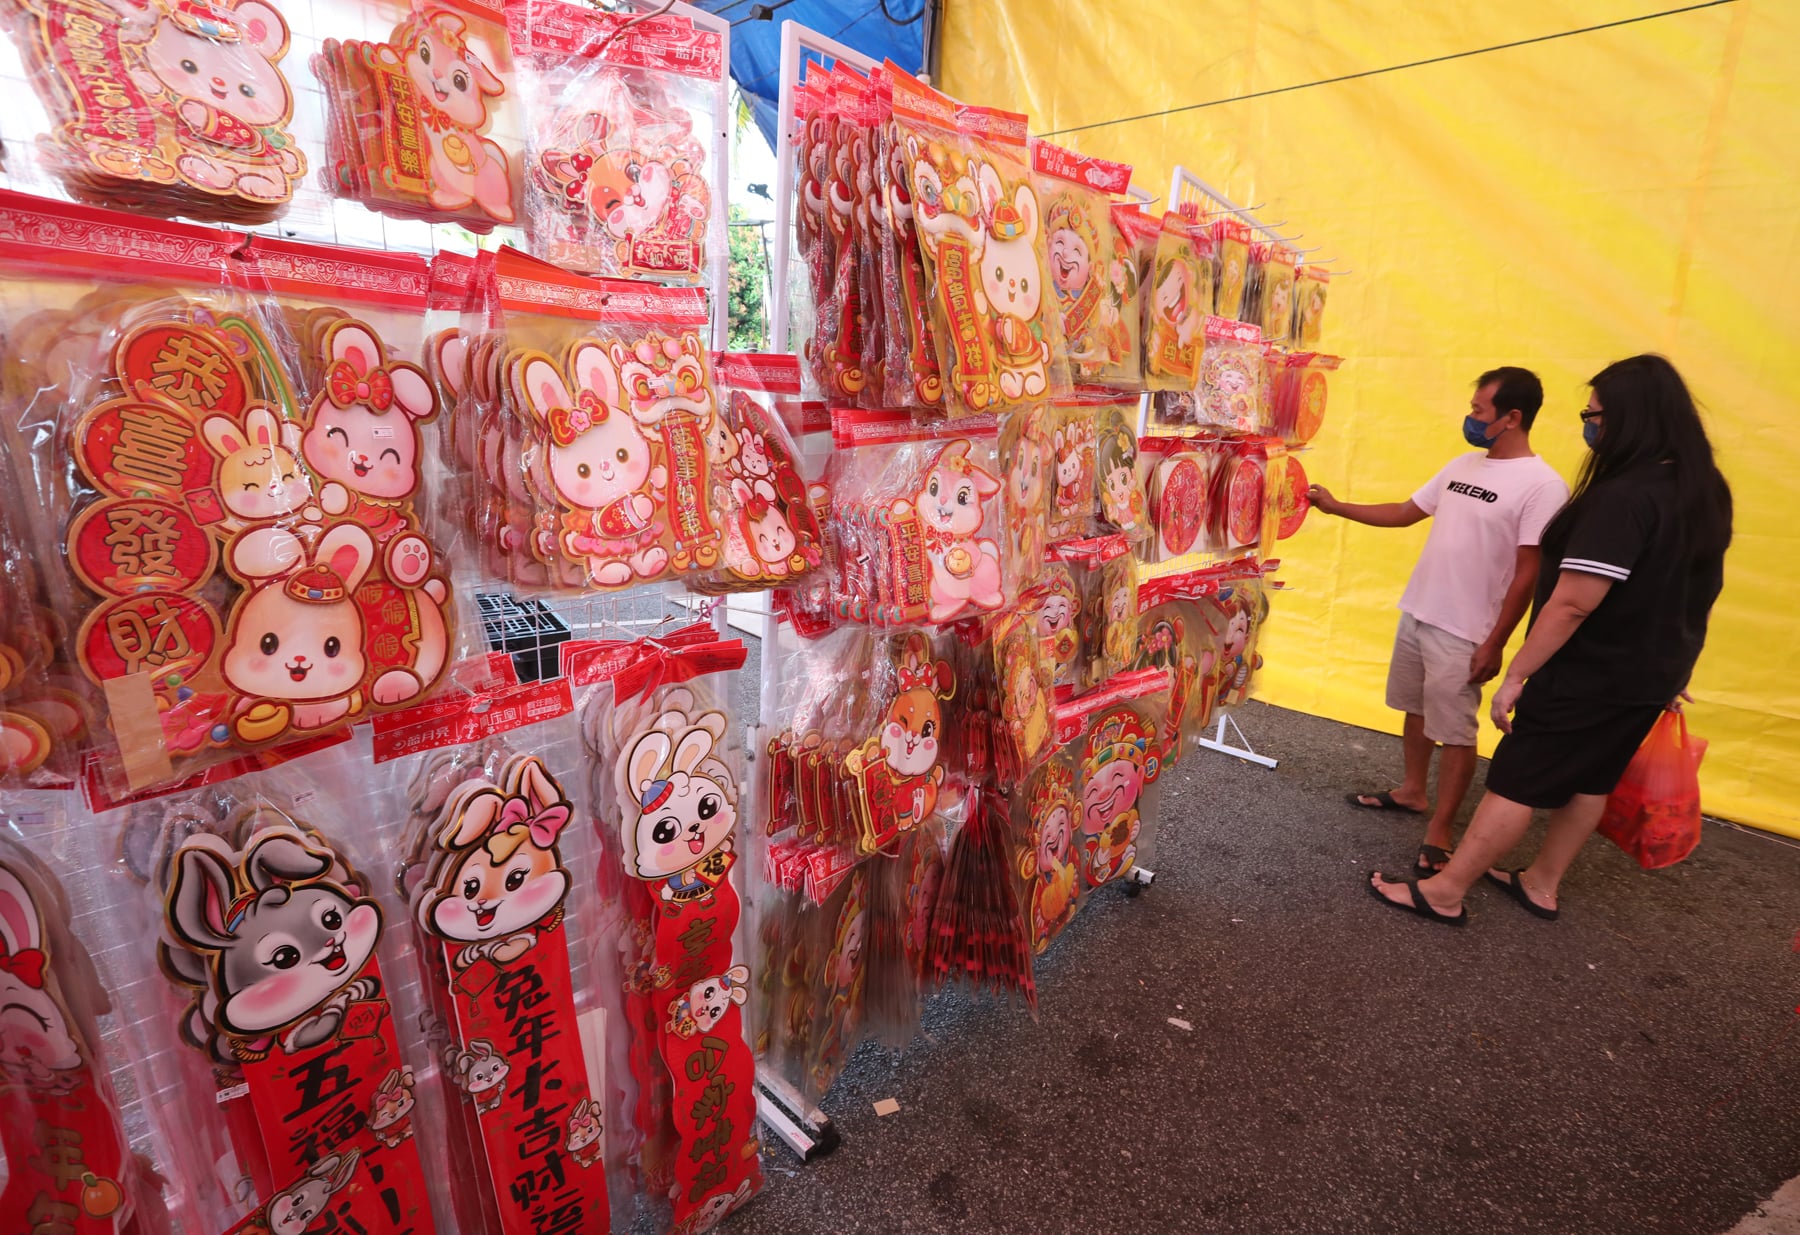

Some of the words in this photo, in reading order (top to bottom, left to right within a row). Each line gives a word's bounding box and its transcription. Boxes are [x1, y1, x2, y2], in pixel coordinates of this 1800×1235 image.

[1446, 480, 1499, 503] WEEKEND
[901, 522, 924, 605] 平安喜樂
[702, 852, 726, 877] 福
